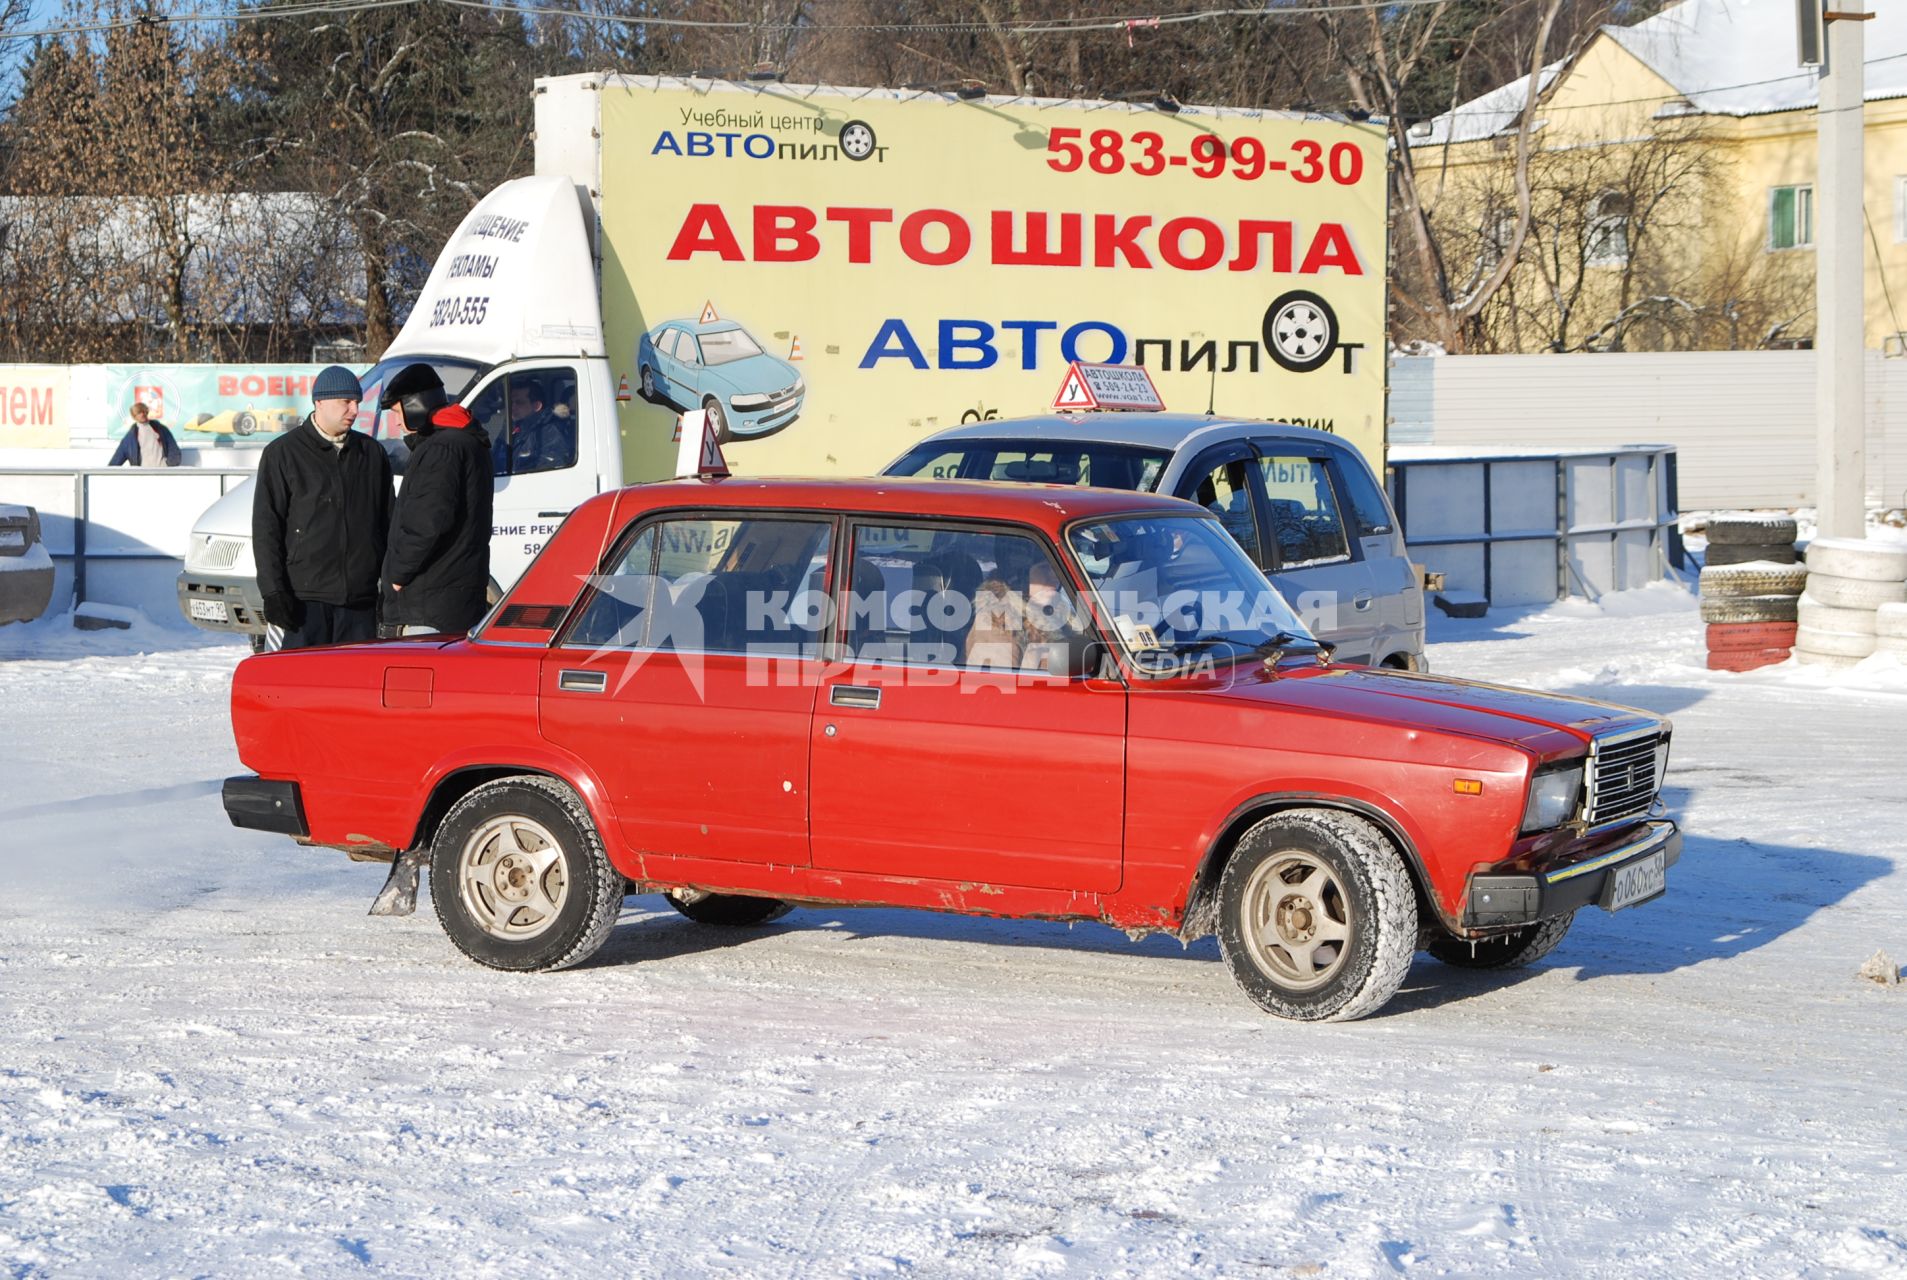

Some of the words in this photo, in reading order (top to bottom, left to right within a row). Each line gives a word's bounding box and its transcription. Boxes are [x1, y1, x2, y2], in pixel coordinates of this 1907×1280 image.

[680, 107, 764, 129] Учебный
[770, 114, 824, 135] центр
[1046, 127, 1364, 186] 583-99-30
[666, 202, 1365, 276] АВТОШКОЛА
[430, 296, 490, 328] 582-0-555
[1085, 368, 1146, 383] АВТОШКОЛА
[530, 524, 560, 535] РЕК
